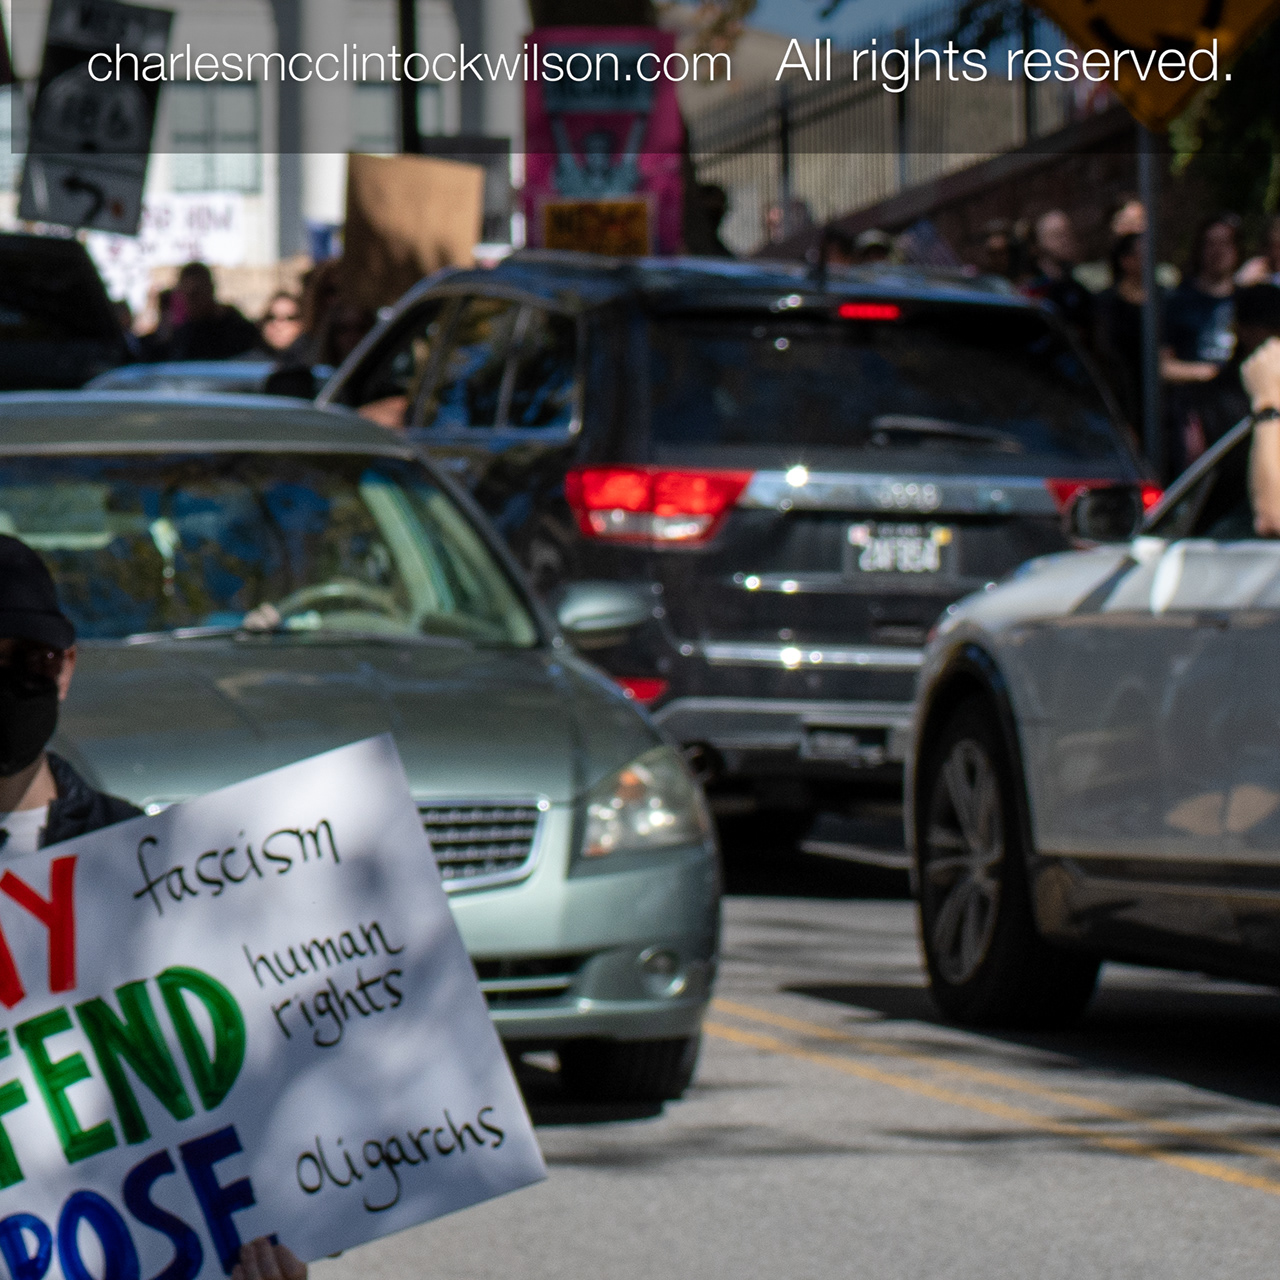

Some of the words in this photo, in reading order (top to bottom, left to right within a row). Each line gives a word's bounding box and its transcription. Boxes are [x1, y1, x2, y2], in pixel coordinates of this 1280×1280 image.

[133, 818, 341, 917] fascism
[243, 920, 405, 988] human
[271, 968, 404, 1048] rights
[296, 1106, 505, 1214] oligarchs
